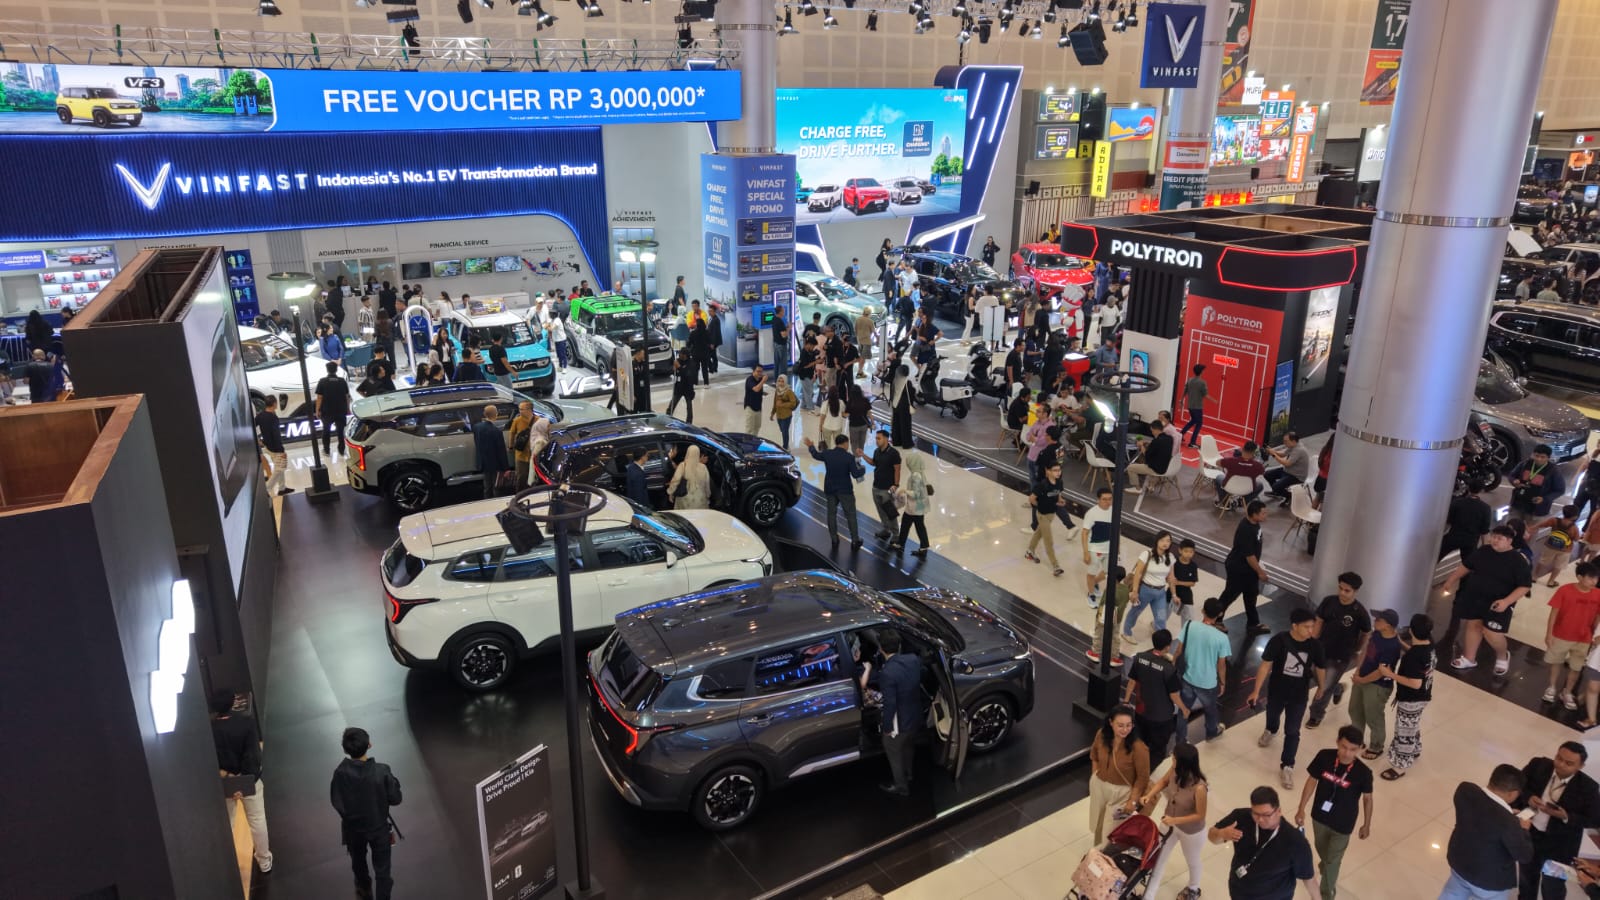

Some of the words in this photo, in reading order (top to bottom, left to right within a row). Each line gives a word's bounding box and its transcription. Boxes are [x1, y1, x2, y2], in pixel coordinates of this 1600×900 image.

[1153, 66, 1198, 77] VINFAST
[323, 89, 398, 113] FREE
[405, 88, 541, 112] VOUCHER
[549, 88, 582, 110] RP
[799, 126, 851, 139] CHARGE
[854, 125, 887, 140] FREE,
[799, 145, 838, 158] DRIVE
[840, 143, 898, 158] FURTHER.
[175, 173, 308, 194] VINFAST
[317, 172, 400, 187] Indonesia's
[403, 171, 436, 183] No.1
[438, 169, 457, 182] EV
[460, 165, 558, 180] Transformation
[560, 163, 598, 177] Brand
[747, 178, 787, 189] VINFAST
[747, 192, 785, 201] SPECIAL
[749, 203, 784, 214] PROMO
[429, 241, 462, 249] FINANCIAL
[463, 239, 489, 247] SERVICE
[318, 248, 371, 257] ADMINISTRATION
[1111, 239, 1203, 269] POLYTRON
[1216, 313, 1263, 330] POLYTRON
[484, 780, 504, 794] World
[504, 769, 520, 782] Class
[486, 788, 503, 802] Drive
[503, 776, 521, 792] Proud
[525, 768, 535, 777] Kia
